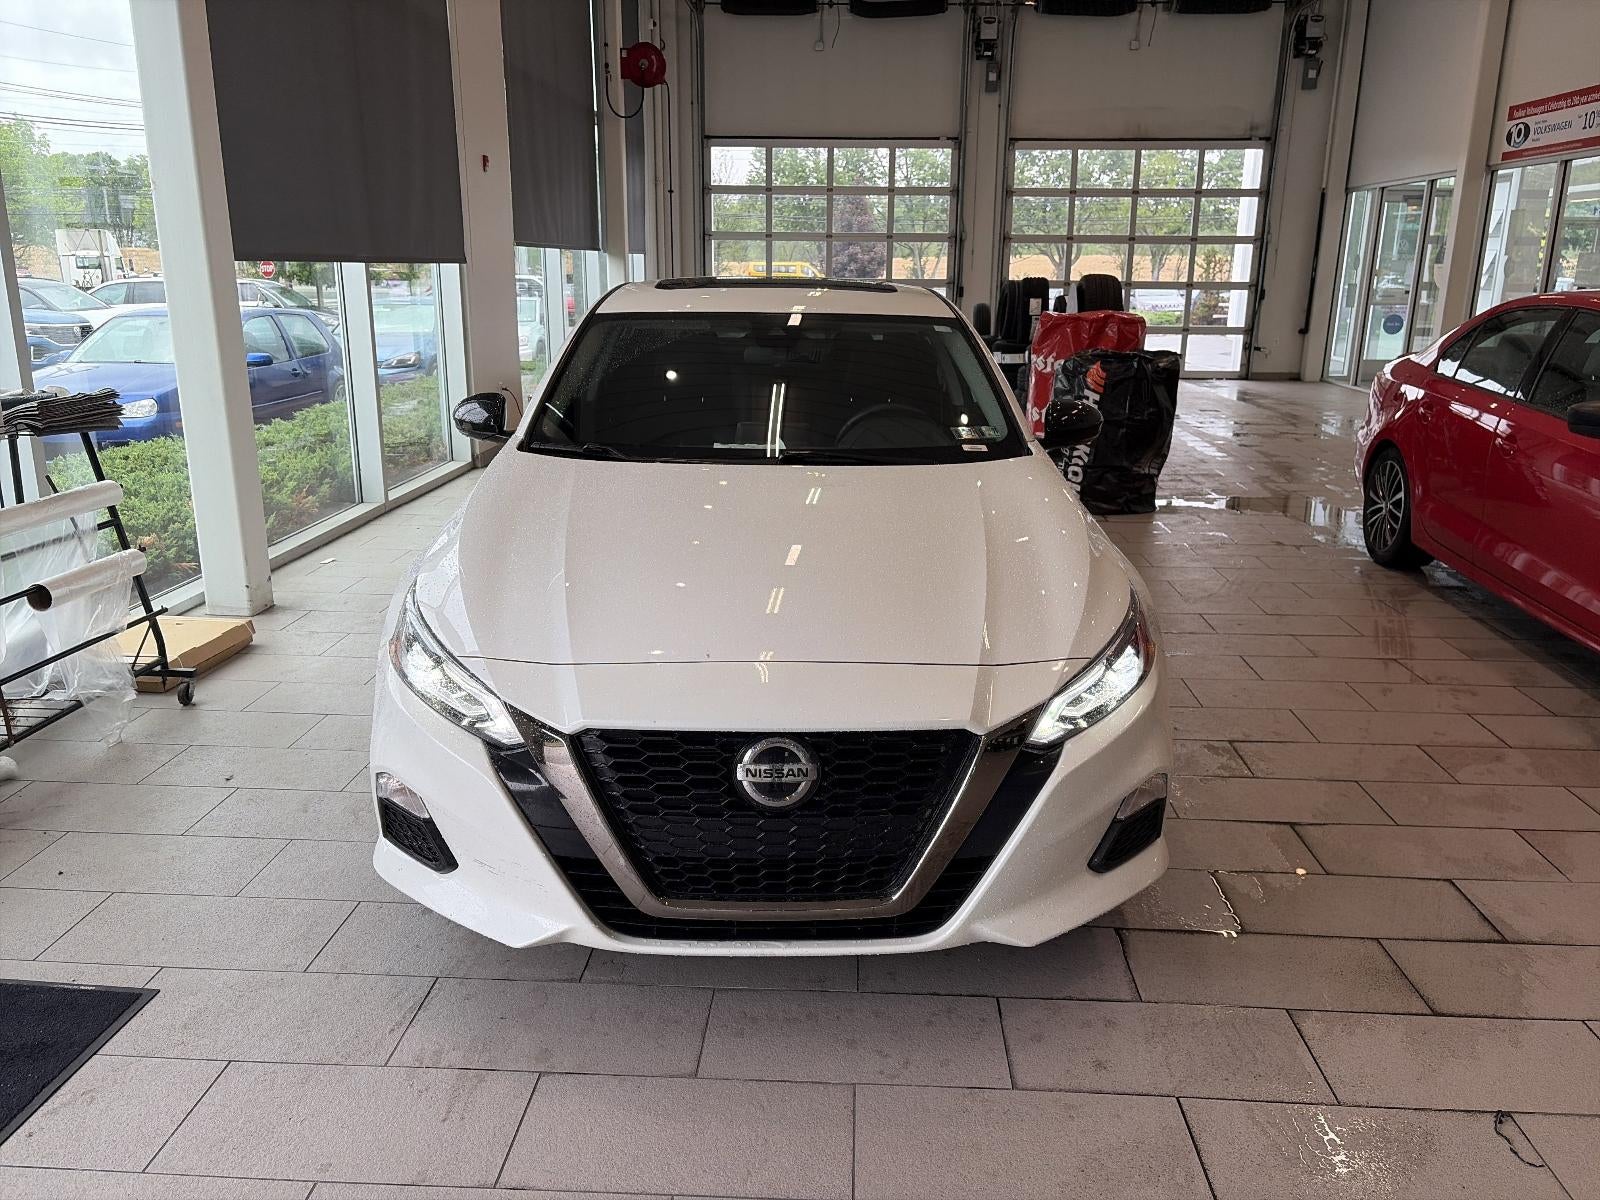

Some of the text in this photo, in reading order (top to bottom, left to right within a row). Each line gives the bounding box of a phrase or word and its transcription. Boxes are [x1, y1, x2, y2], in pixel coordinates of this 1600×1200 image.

[1582, 110, 1596, 130] 10
[1533, 120, 1573, 136] VOLKSWAGEN
[261, 264, 273, 273] STOP
[745, 767, 809, 779] NISSAN
